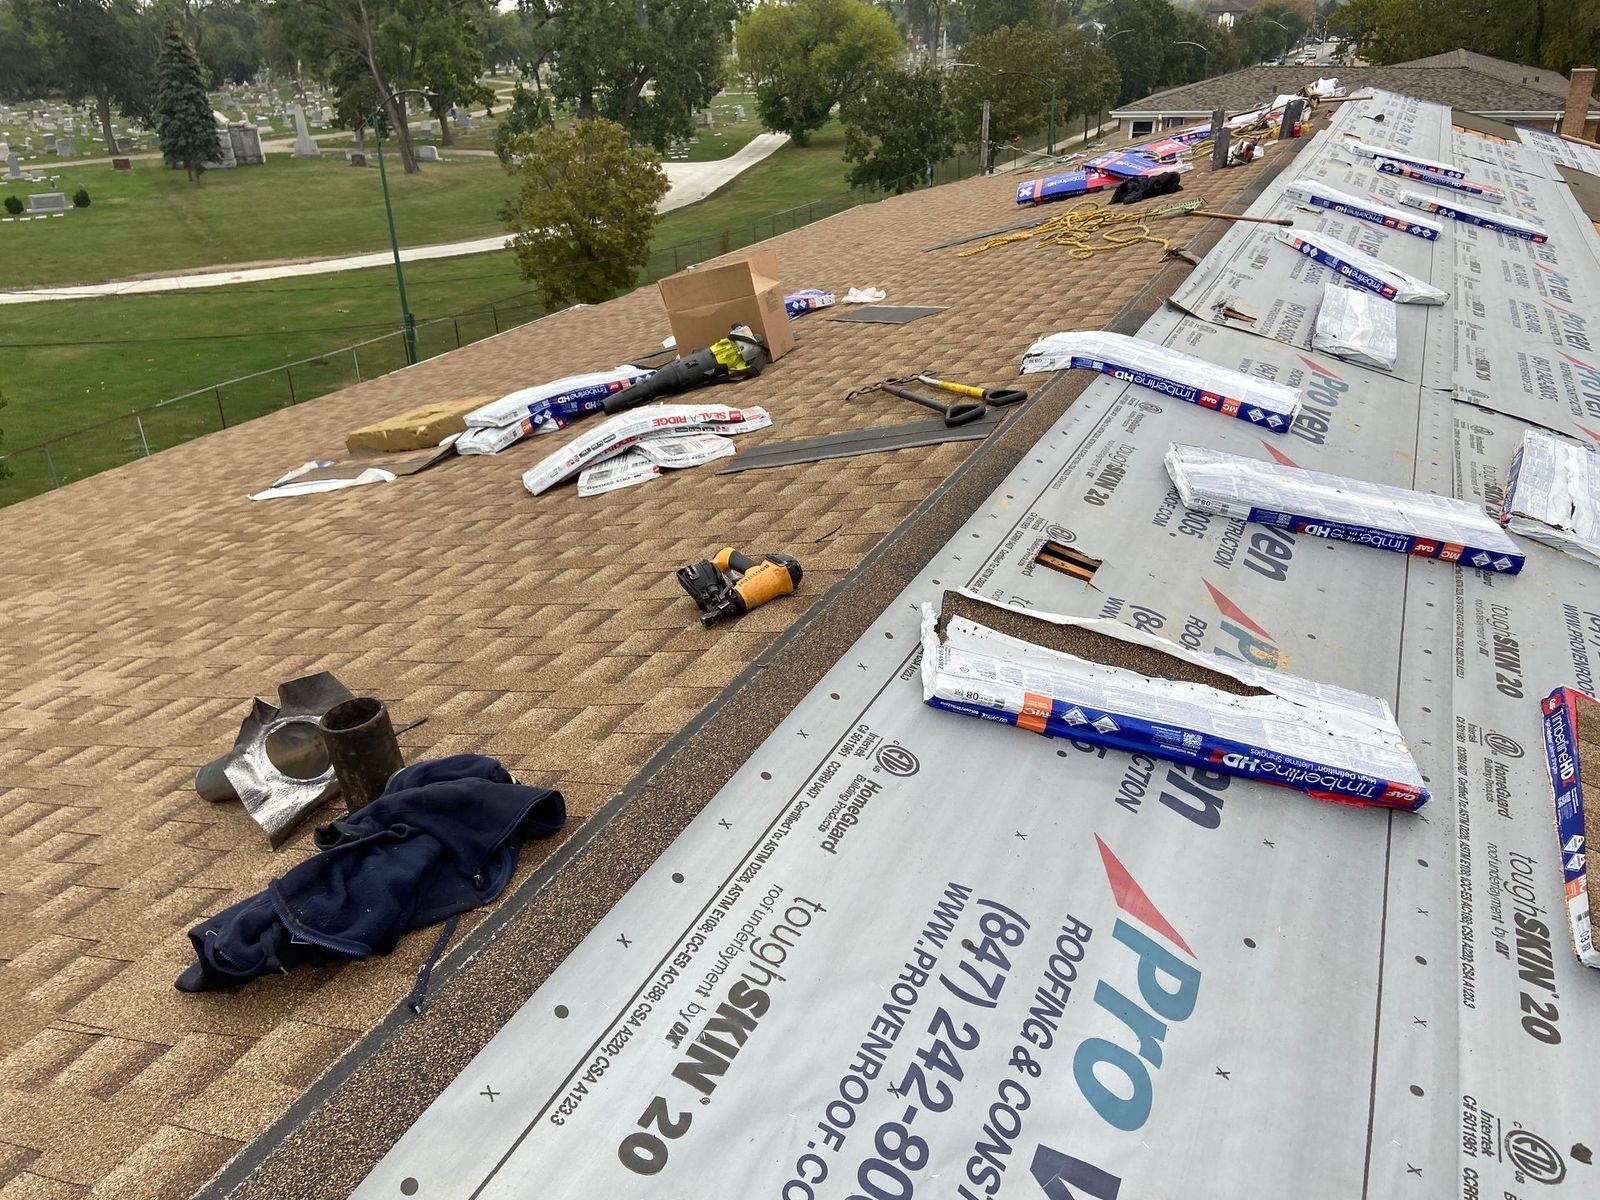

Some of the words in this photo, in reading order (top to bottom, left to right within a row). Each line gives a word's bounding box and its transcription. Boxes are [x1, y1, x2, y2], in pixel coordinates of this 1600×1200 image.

[1083, 488, 1110, 506] 20
[966, 691, 980, 701] 08
[1495, 672, 1525, 699] 20
[1250, 747, 1284, 764] Shingles
[838, 773, 867, 802] Building
[1359, 772, 1378, 785] High
[1494, 761, 1514, 820] HomeGuard
[1385, 789, 1417, 802] GAF
[782, 800, 811, 831] Certified
[817, 798, 849, 834] Products
[820, 778, 885, 856] HomeGuard
[757, 840, 780, 865] ASTM
[717, 885, 745, 918] ASTM
[762, 883, 784, 915] roof
[1485, 859, 1504, 924] underlayment
[1461, 925, 1474, 943] CSA
[1492, 925, 1509, 940] by
[1503, 852, 1557, 993] toughSKIN
[672, 931, 708, 970] ICC-ES
[695, 904, 765, 999] underlayment
[938, 897, 1031, 1009] (847)
[1019, 913, 1094, 1051] ROOFING
[1462, 962, 1475, 981] CSA
[670, 896, 828, 1097] toughSKIN
[679, 1000, 707, 1025] by
[627, 1000, 654, 1030] CSA
[1519, 991, 1562, 1045] 20
[664, 1020, 690, 1050] OX
[581, 1055, 612, 1085] CSA
[1008, 1045, 1043, 1079] &
[549, 1081, 590, 1127] A123.3
[844, 1005, 982, 1200] 242-80
[617, 1095, 693, 1177] 20
[1462, 1110, 1478, 1159] 5011961
[1480, 1109, 1495, 1158] Intertek
